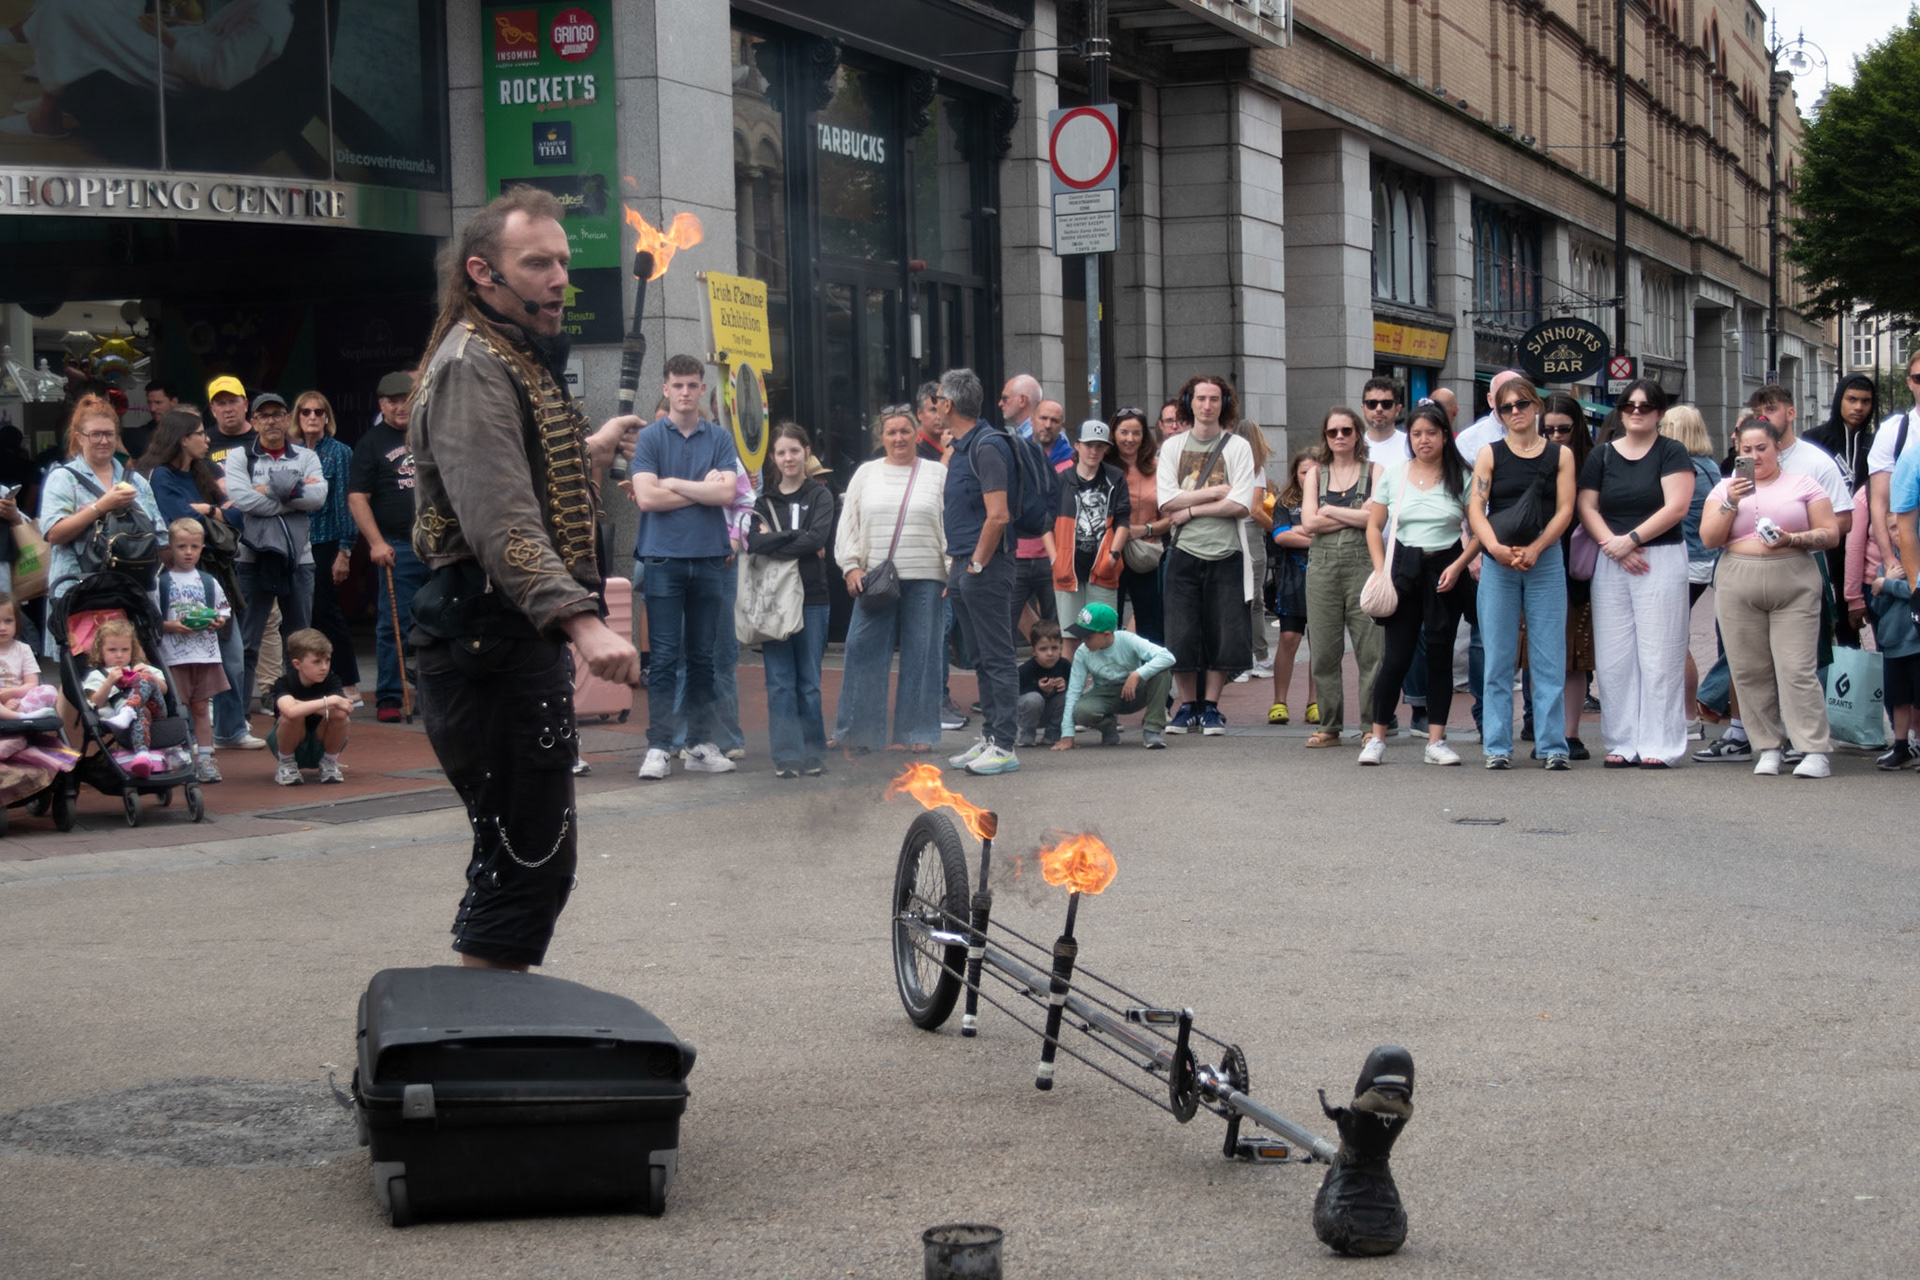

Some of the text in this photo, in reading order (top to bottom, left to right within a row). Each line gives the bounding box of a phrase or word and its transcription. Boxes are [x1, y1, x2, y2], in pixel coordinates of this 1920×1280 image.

[570, 14, 578, 24] EL
[554, 24, 594, 43] GRINGO
[497, 50, 538, 61] INSOMNIA
[500, 74, 596, 105] ROCKET'S
[538, 145, 567, 157] THAI
[817, 123, 885, 164] TARBUCKS
[208, 182, 346, 218] CENTRE
[711, 281, 764, 309] Irish Famine
[567, 311, 596, 321] Seats
[720, 308, 762, 332] Exhibition
[1526, 326, 1602, 356] SINNOTTS
[1544, 360, 1583, 374] BAR
[1828, 698, 1853, 710] GRANTS
